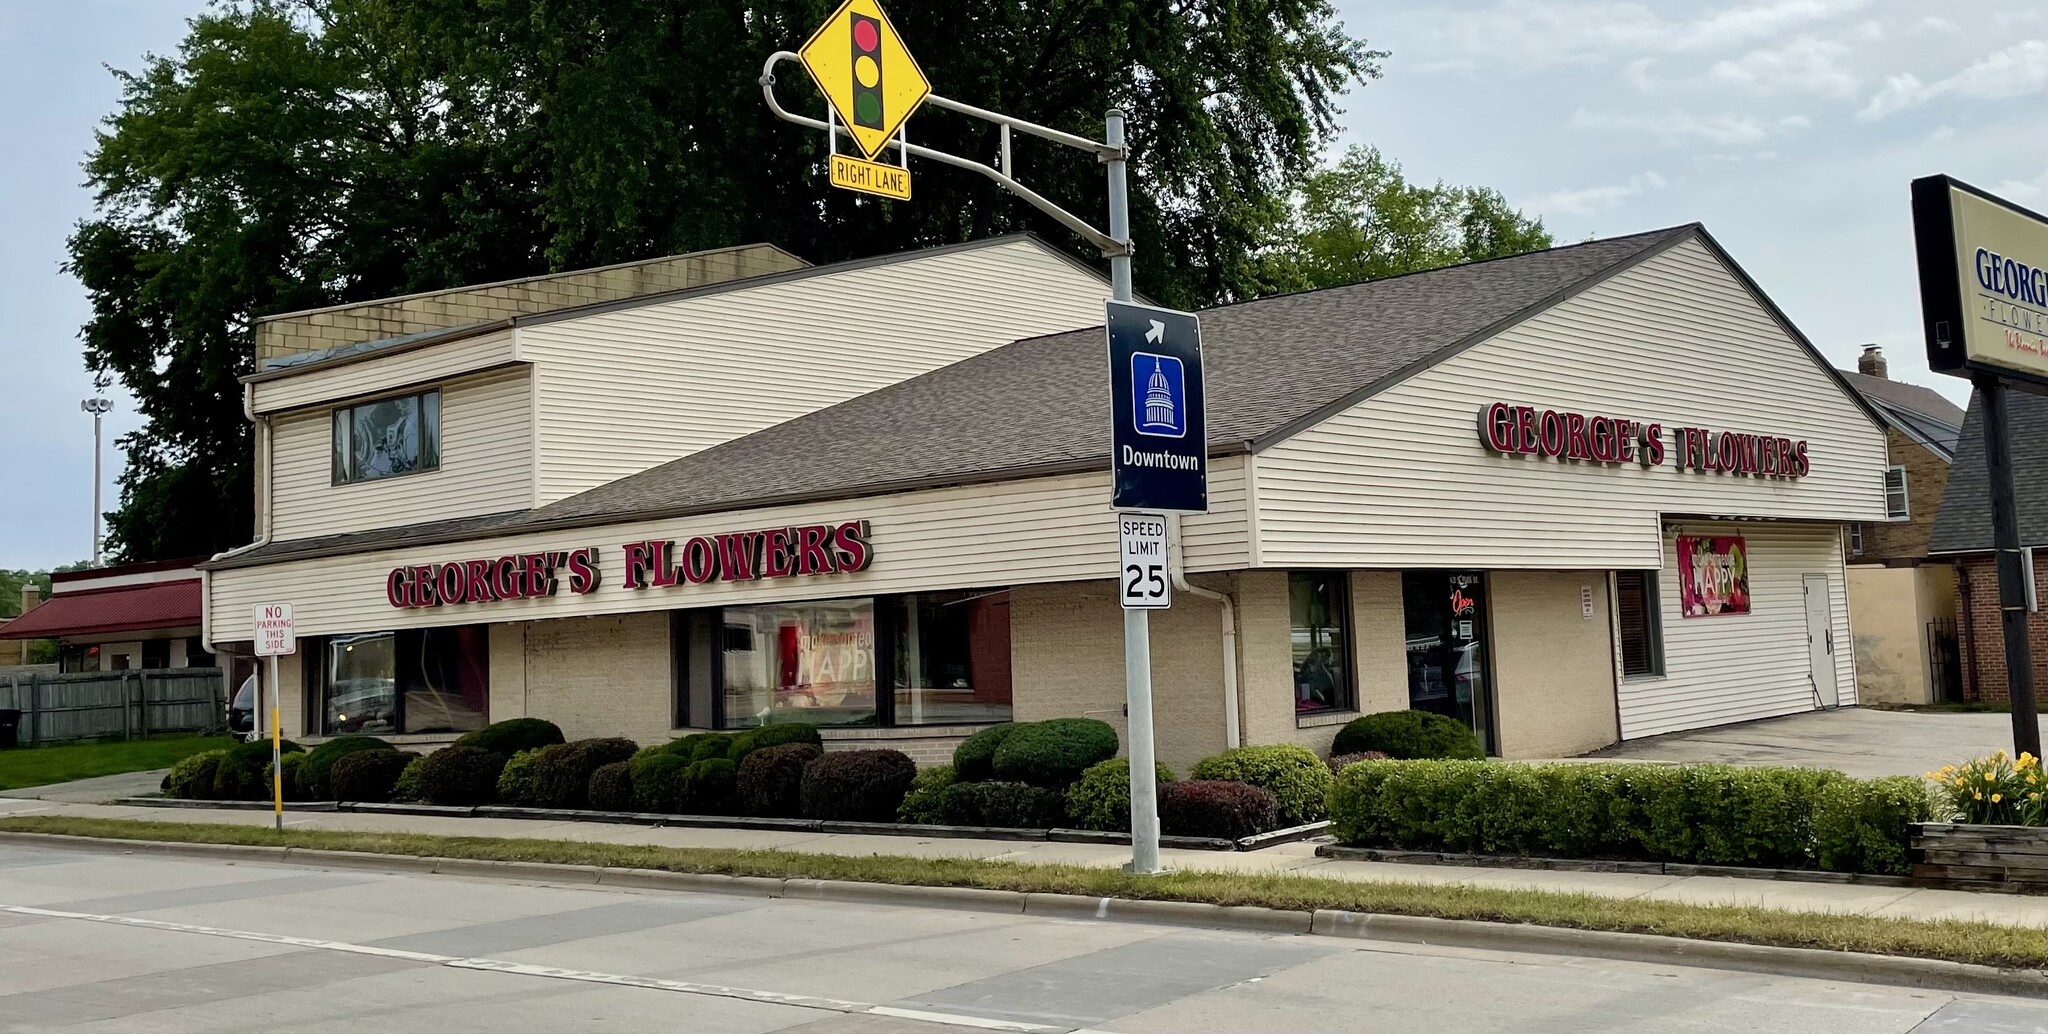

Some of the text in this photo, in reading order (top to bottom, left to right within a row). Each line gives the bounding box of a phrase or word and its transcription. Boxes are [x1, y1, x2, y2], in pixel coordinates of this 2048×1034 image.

[837, 161, 904, 193] RIGHT LANE
[1975, 248, 2048, 308] GEORG
[1989, 300, 2048, 332] FLOWE
[1481, 402, 1809, 478] GEORGE'S FLOWERS
[1123, 444, 1199, 471] Downtown
[1123, 521, 1163, 537] SPEED
[1128, 541, 1160, 556] LIMIT
[387, 520, 872, 609] GEORGE'S FLOWERS
[1126, 564, 1165, 598] 25
[1693, 567, 1736, 596] HAPPY
[265, 606, 282, 618] NO
[1453, 589, 1475, 616] Open
[257, 619, 291, 629] PARKING
[265, 629, 285, 639] THIS
[265, 640, 285, 650] SIDE
